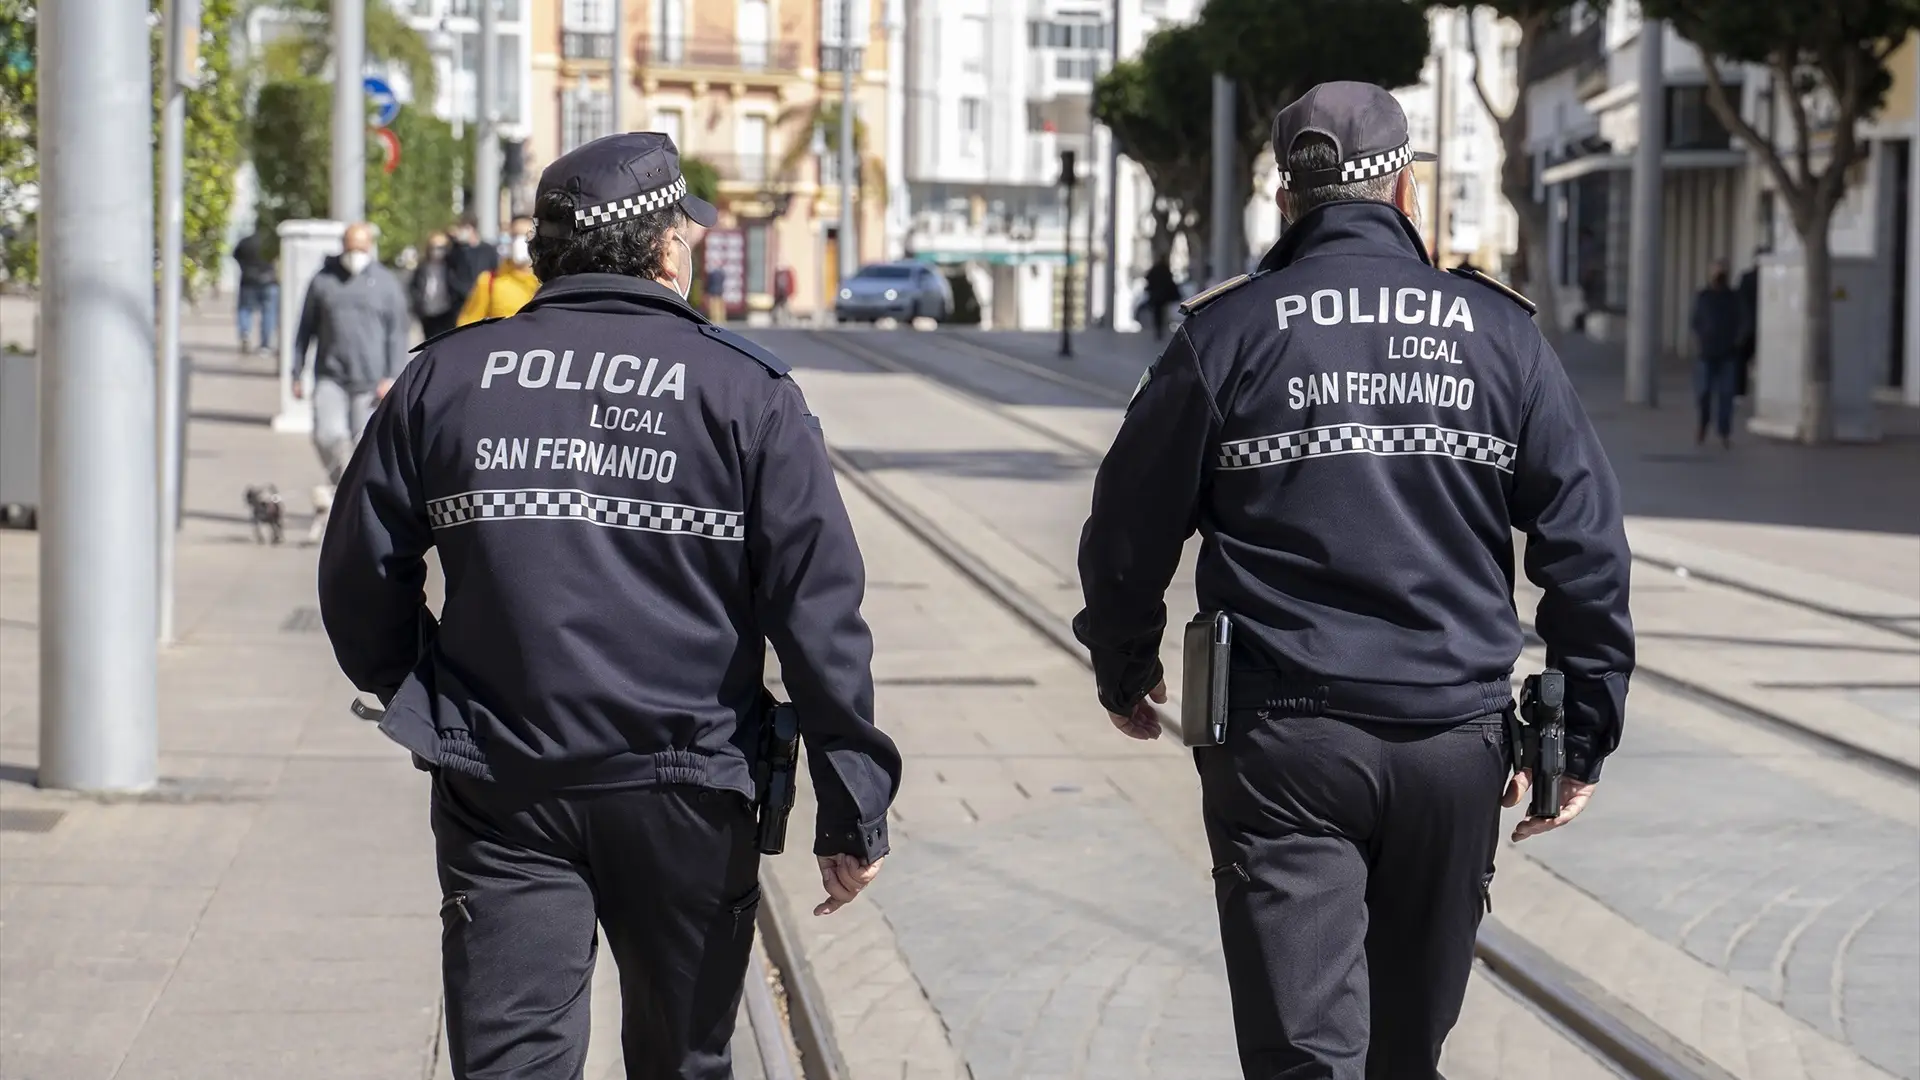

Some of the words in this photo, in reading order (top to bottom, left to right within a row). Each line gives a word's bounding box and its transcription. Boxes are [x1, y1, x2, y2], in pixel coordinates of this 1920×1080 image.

[1275, 287, 1475, 333] POLICIA
[1388, 336, 1463, 365] LOCAL
[480, 349, 686, 401] POLICIA
[1287, 372, 1340, 410] SAN
[1346, 371, 1475, 411] FERNANDO
[589, 404, 667, 436] LOCAL
[474, 437, 530, 470] SAN
[534, 438, 677, 484] FERNANDO
